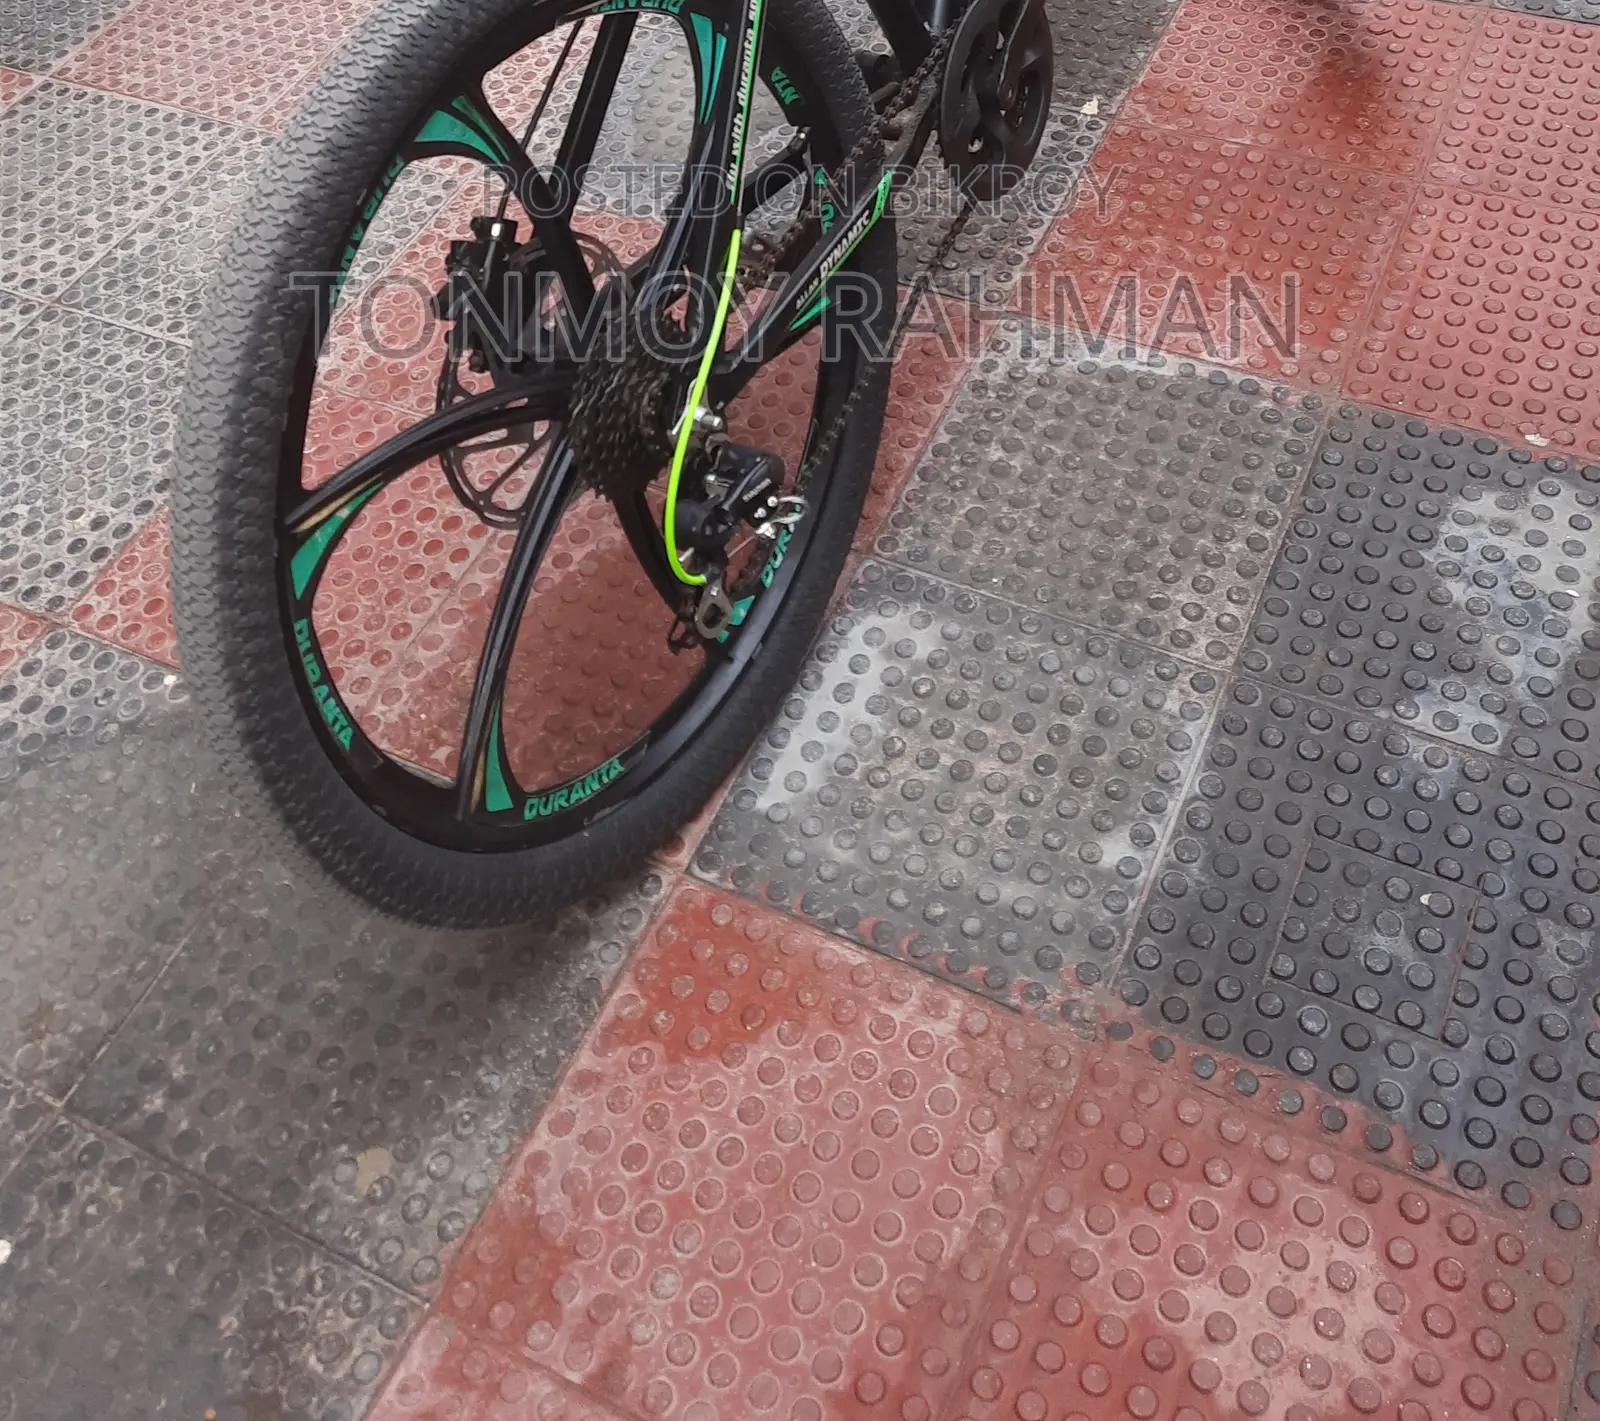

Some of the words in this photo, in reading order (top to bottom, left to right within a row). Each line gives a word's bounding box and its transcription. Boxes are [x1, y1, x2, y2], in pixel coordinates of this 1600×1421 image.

[732, 113, 743, 157] with
[738, 28, 755, 108] duranta
[819, 209, 871, 280] DYNAMIC
[523, 757, 626, 821] DURANTA
